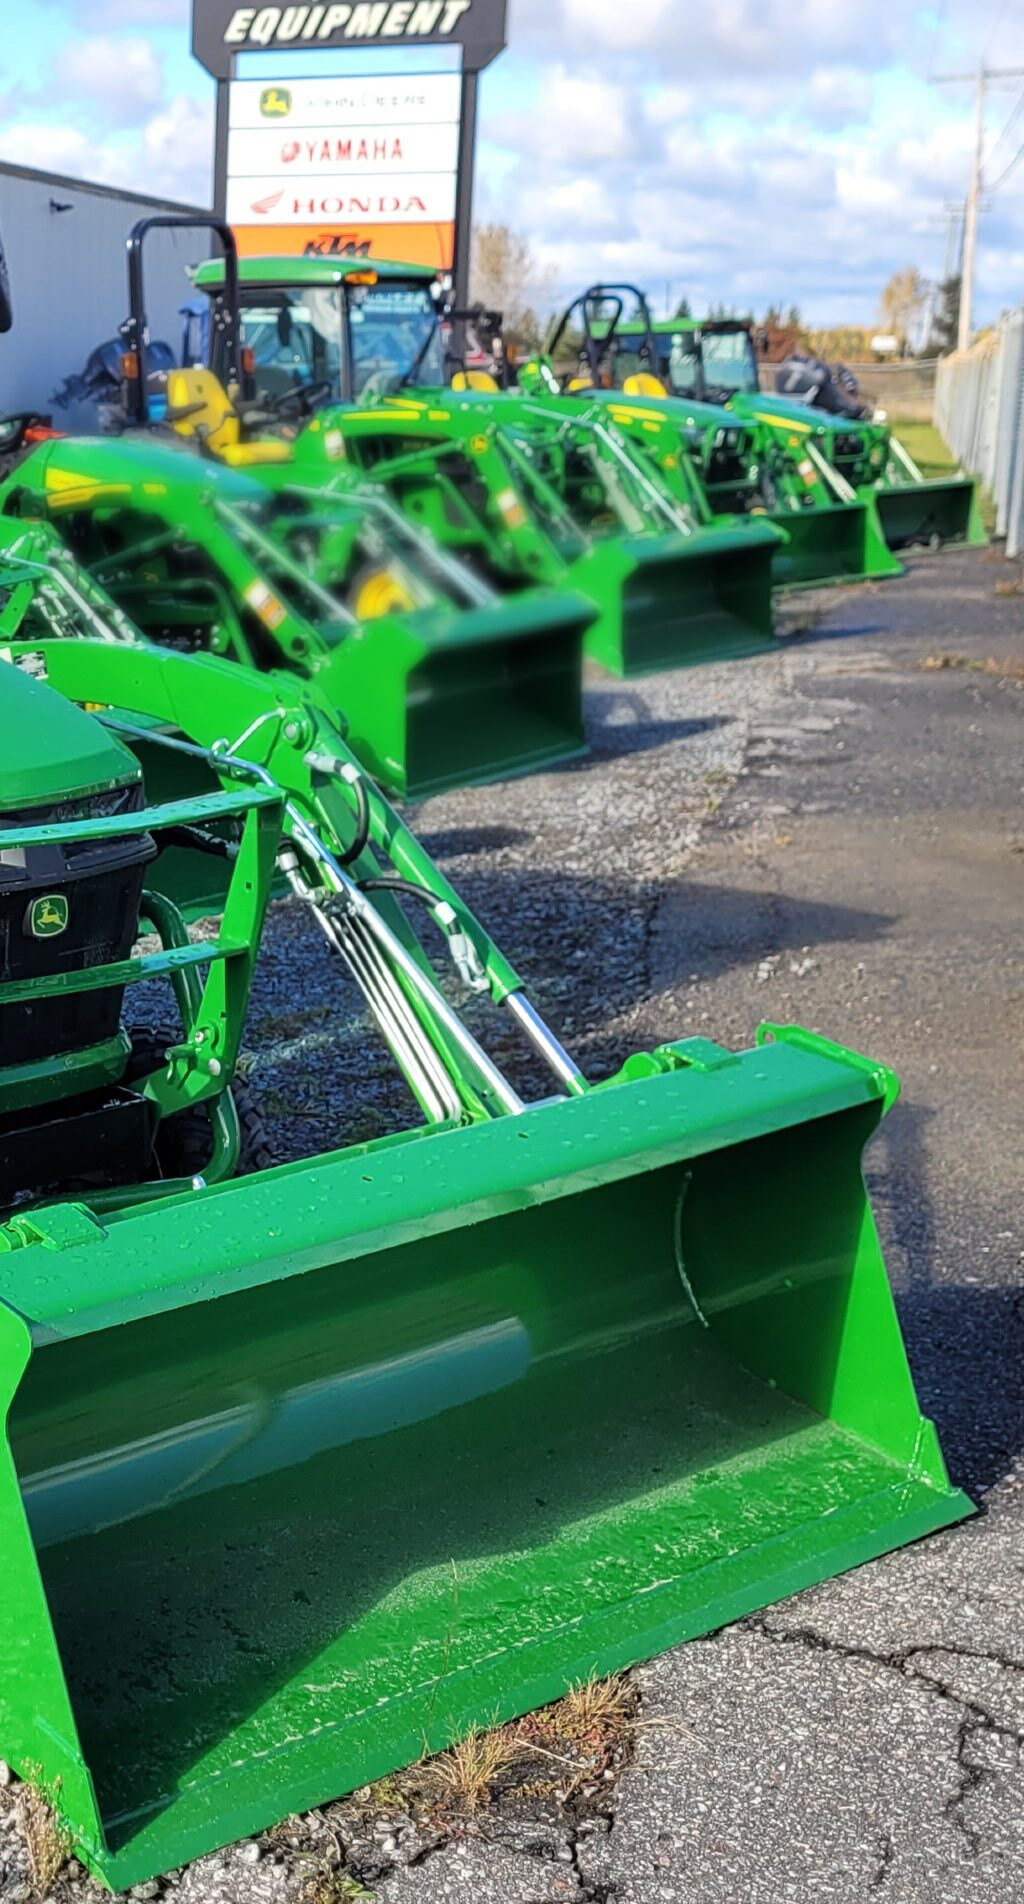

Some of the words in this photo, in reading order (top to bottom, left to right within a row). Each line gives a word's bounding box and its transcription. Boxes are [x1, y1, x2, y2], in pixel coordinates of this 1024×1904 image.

[224, 0, 471, 45] EQUIPMENT
[306, 138, 404, 161] YAMAHA
[292, 196, 427, 214] HONDA
[303, 232, 372, 257] KTM
